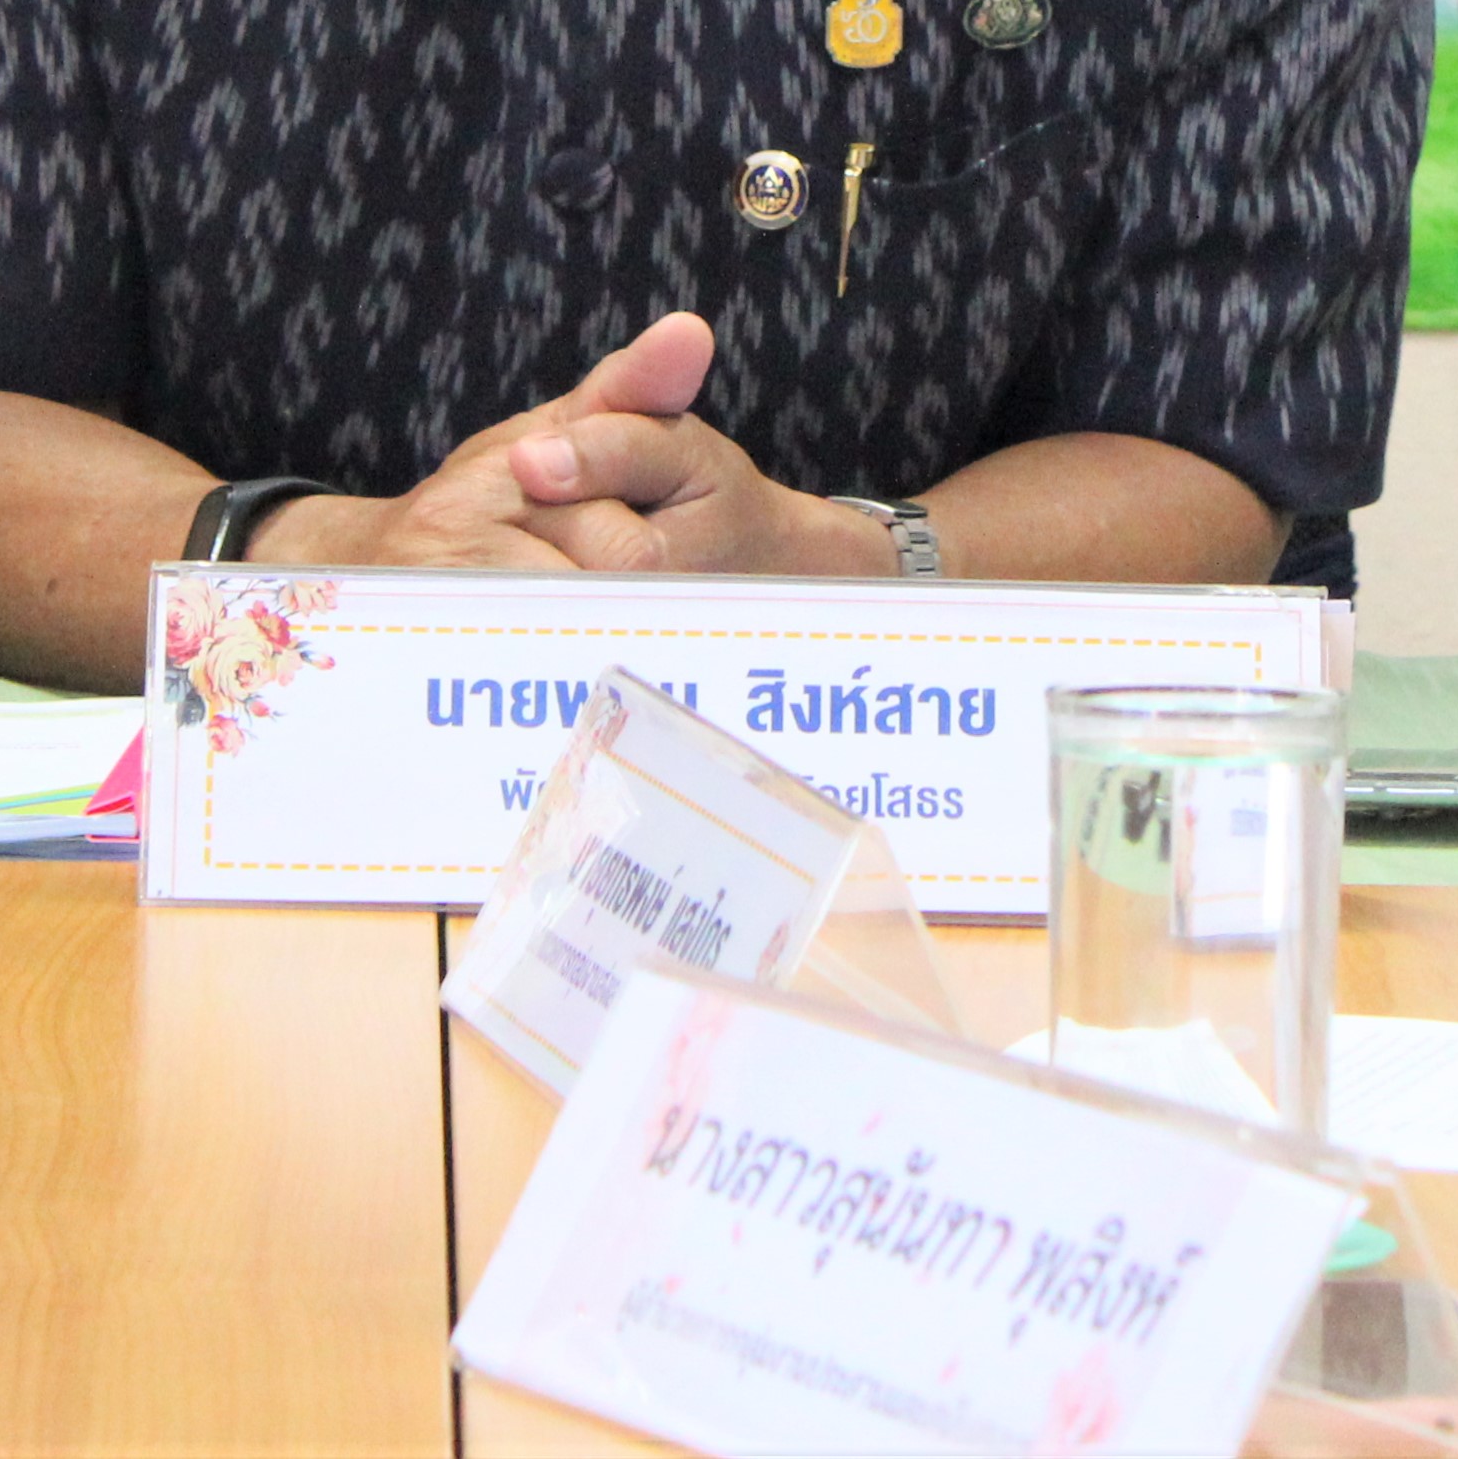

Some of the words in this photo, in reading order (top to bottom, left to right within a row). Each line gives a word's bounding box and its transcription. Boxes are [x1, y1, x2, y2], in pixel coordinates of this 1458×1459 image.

[745, 665, 997, 737] สิงห์สาย
[645, 1104, 1011, 1279] นางสาวสุนันทา
